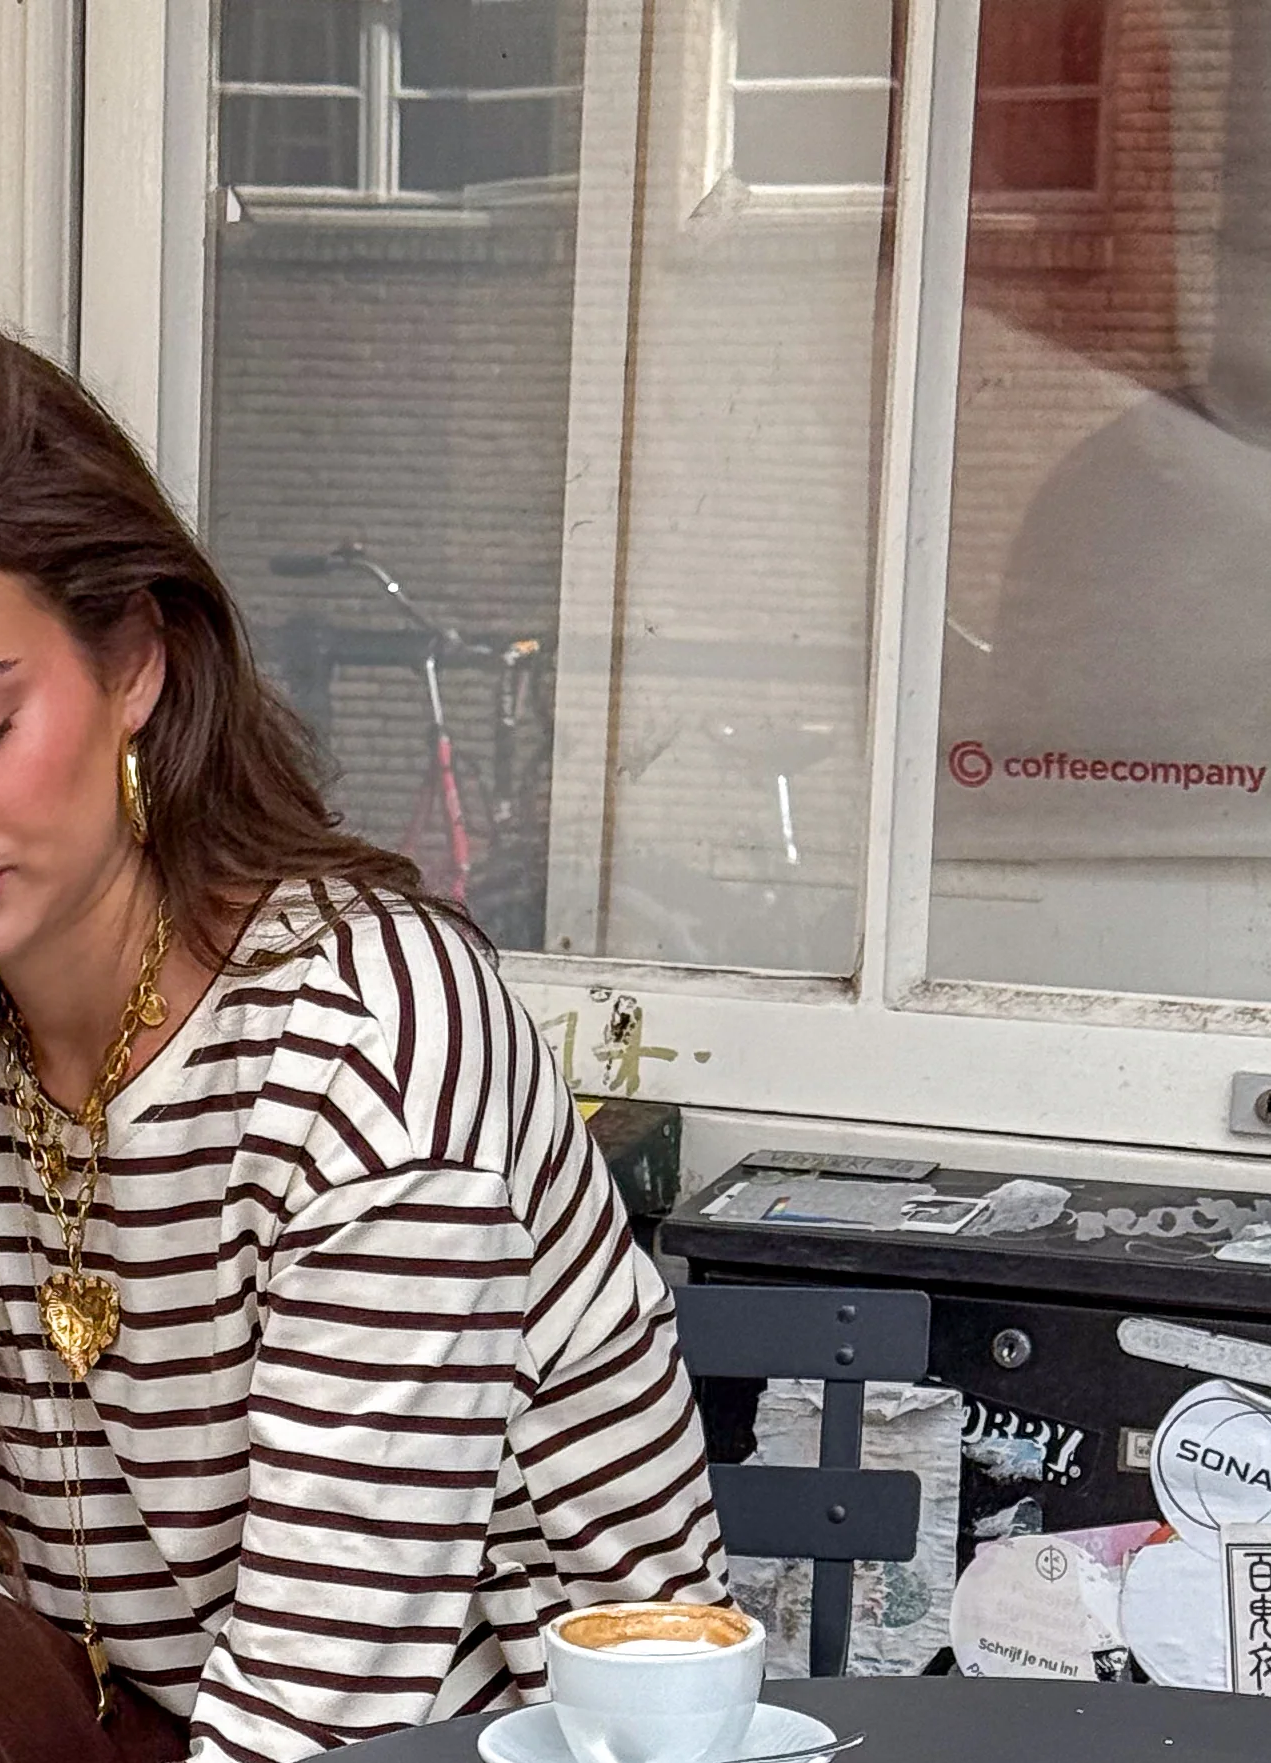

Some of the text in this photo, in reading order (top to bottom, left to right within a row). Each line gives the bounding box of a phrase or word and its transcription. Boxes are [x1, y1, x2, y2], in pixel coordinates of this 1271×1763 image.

[1004, 751, 1266, 793] coffeecompany
[1242, 1551, 1271, 1695] 百鬼夜
[978, 1637, 1022, 1663] Schrijf
[1038, 1659, 1059, 1672] nu
[1059, 1661, 1079, 1677] in!
